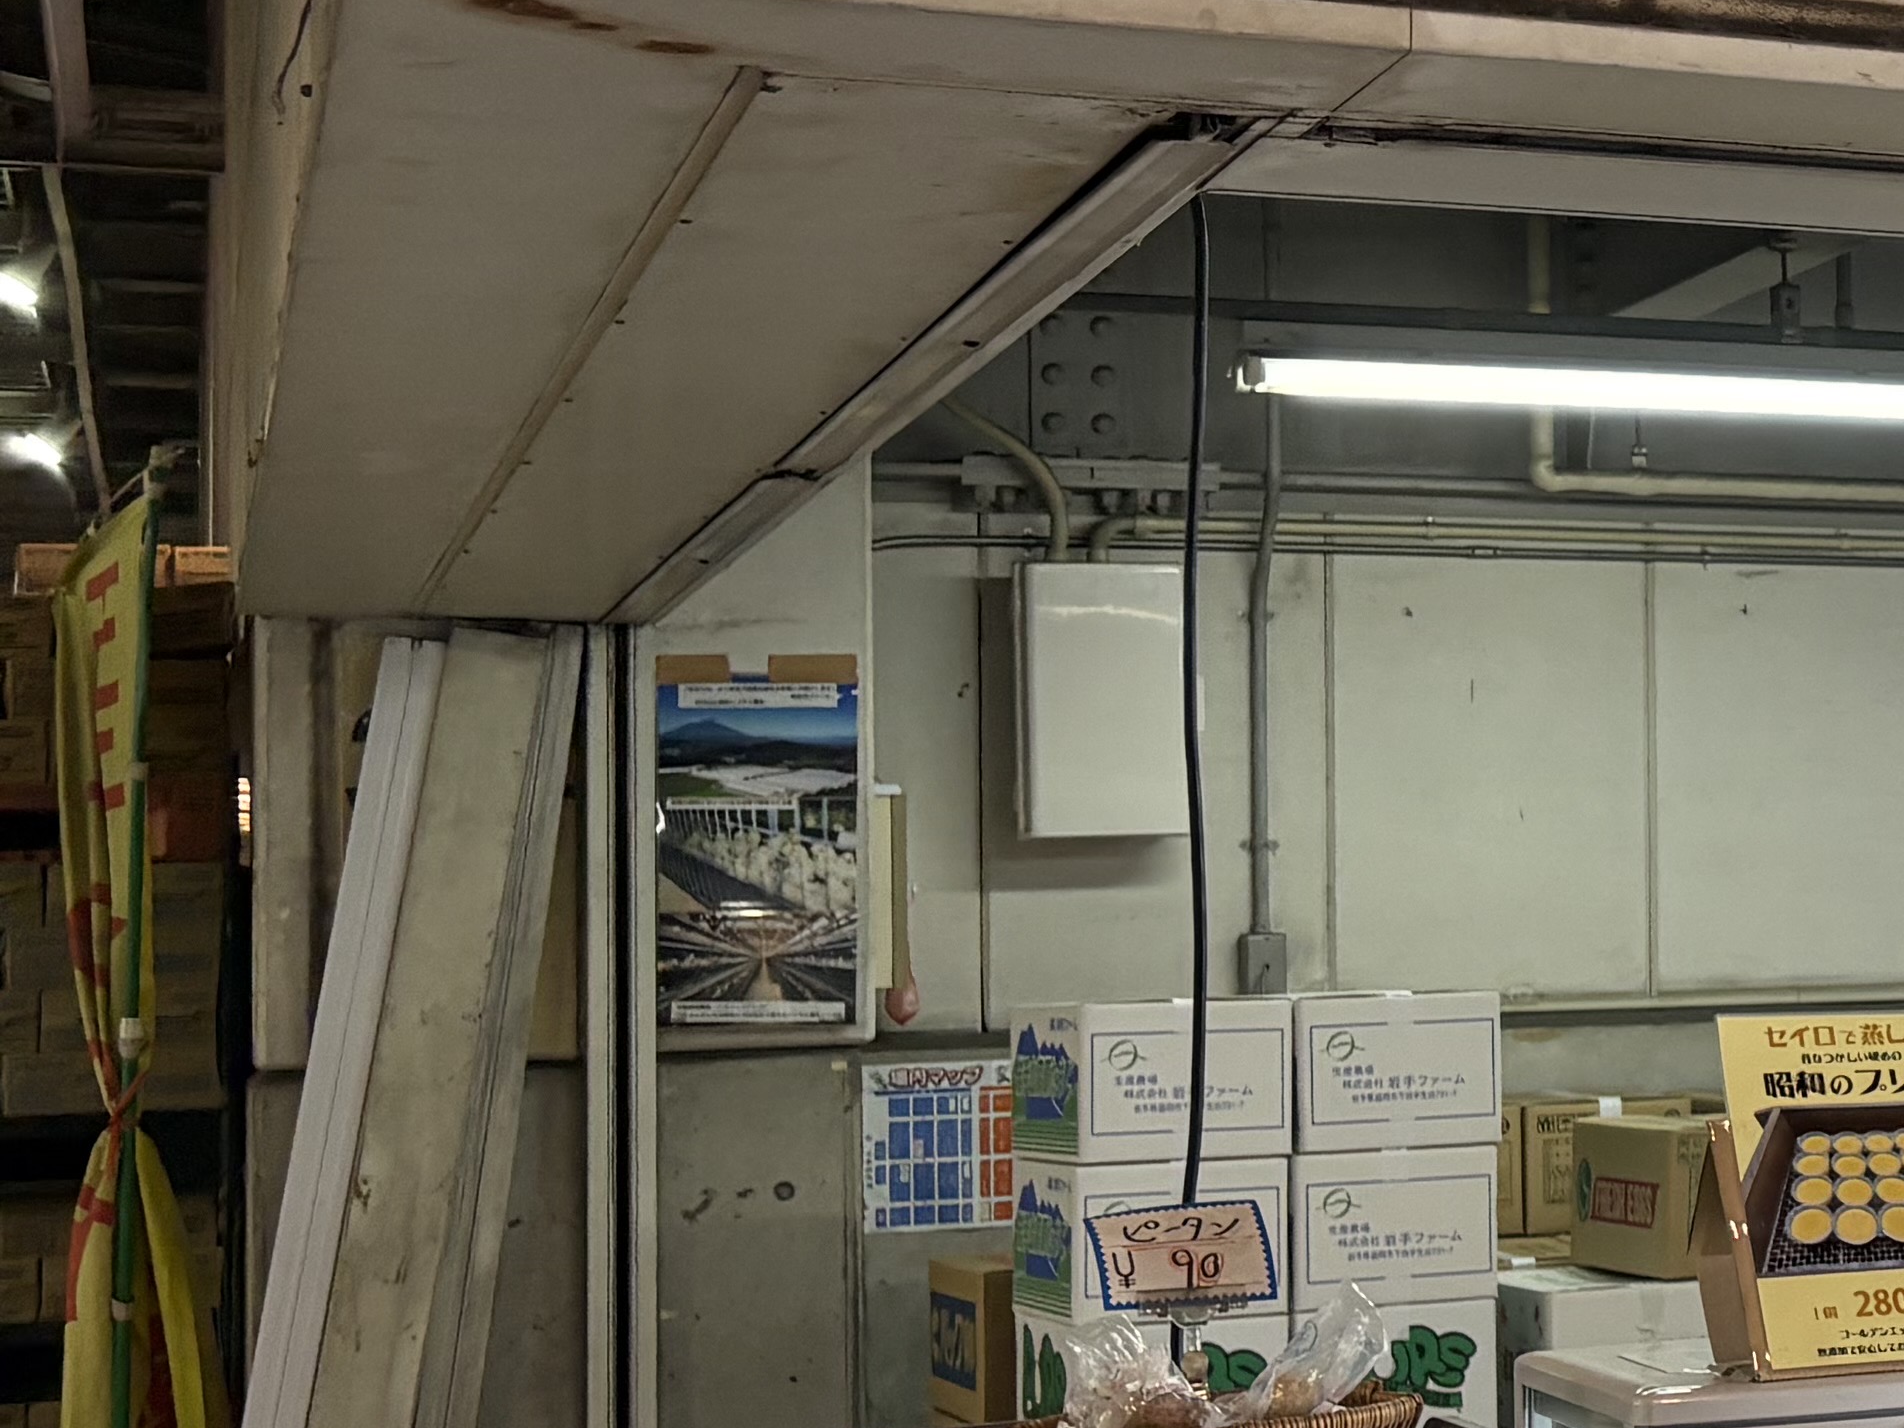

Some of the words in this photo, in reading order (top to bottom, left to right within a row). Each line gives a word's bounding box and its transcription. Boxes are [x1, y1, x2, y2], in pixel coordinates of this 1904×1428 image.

[1172, 1085, 1253, 1101] 岩ファーム
[1123, 1216, 1240, 1242] ピータン
